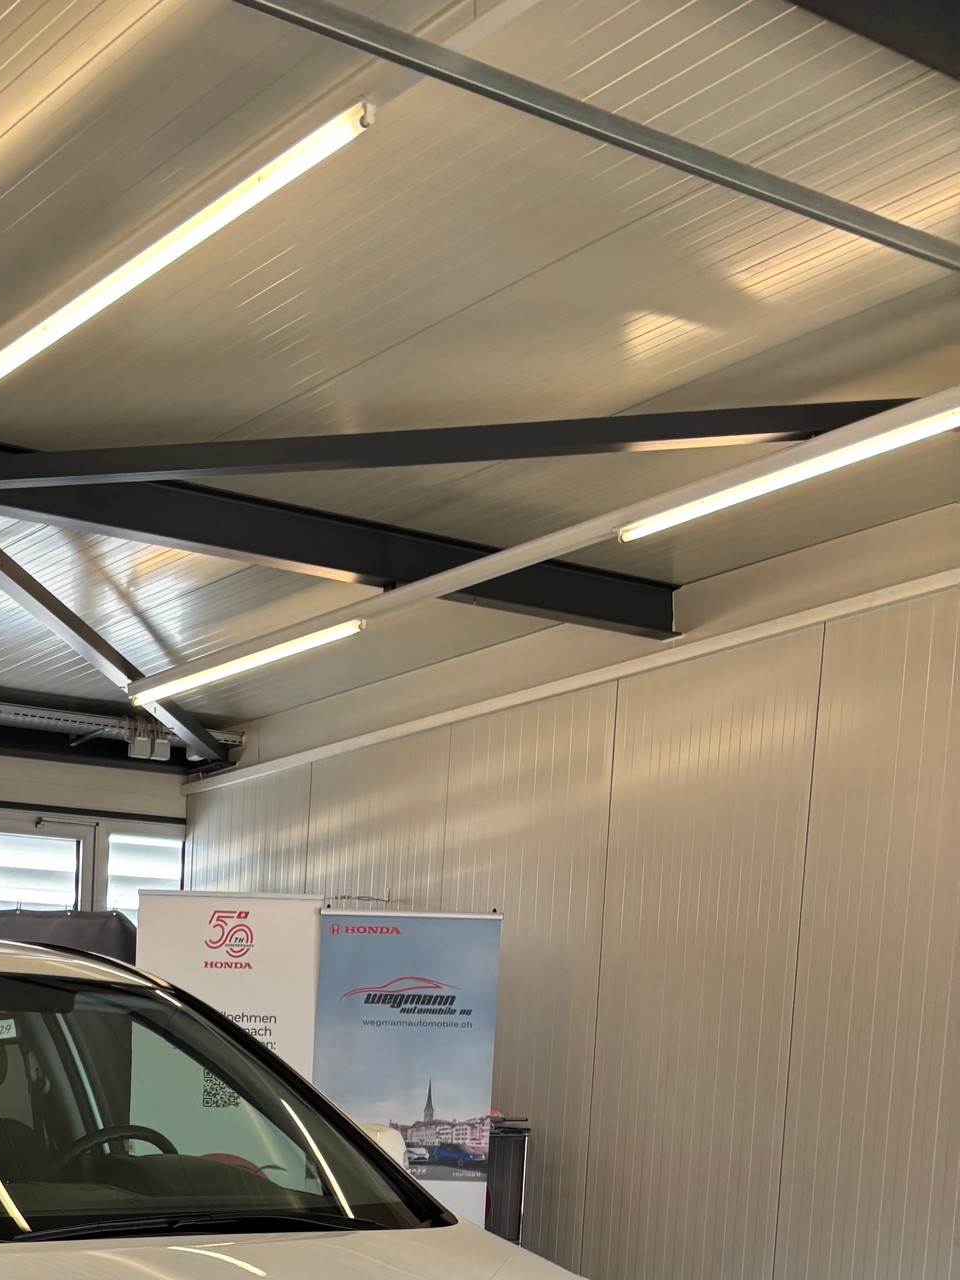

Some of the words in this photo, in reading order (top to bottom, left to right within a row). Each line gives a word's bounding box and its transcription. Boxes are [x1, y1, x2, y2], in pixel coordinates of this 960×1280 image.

[344, 925, 401, 935] HONDA
[203, 961, 253, 970] HONDA
[364, 993, 456, 1009] wegmann
[400, 1006, 457, 1016] automobile
[362, 1020, 472, 1029] wegmannautomobile.ch
